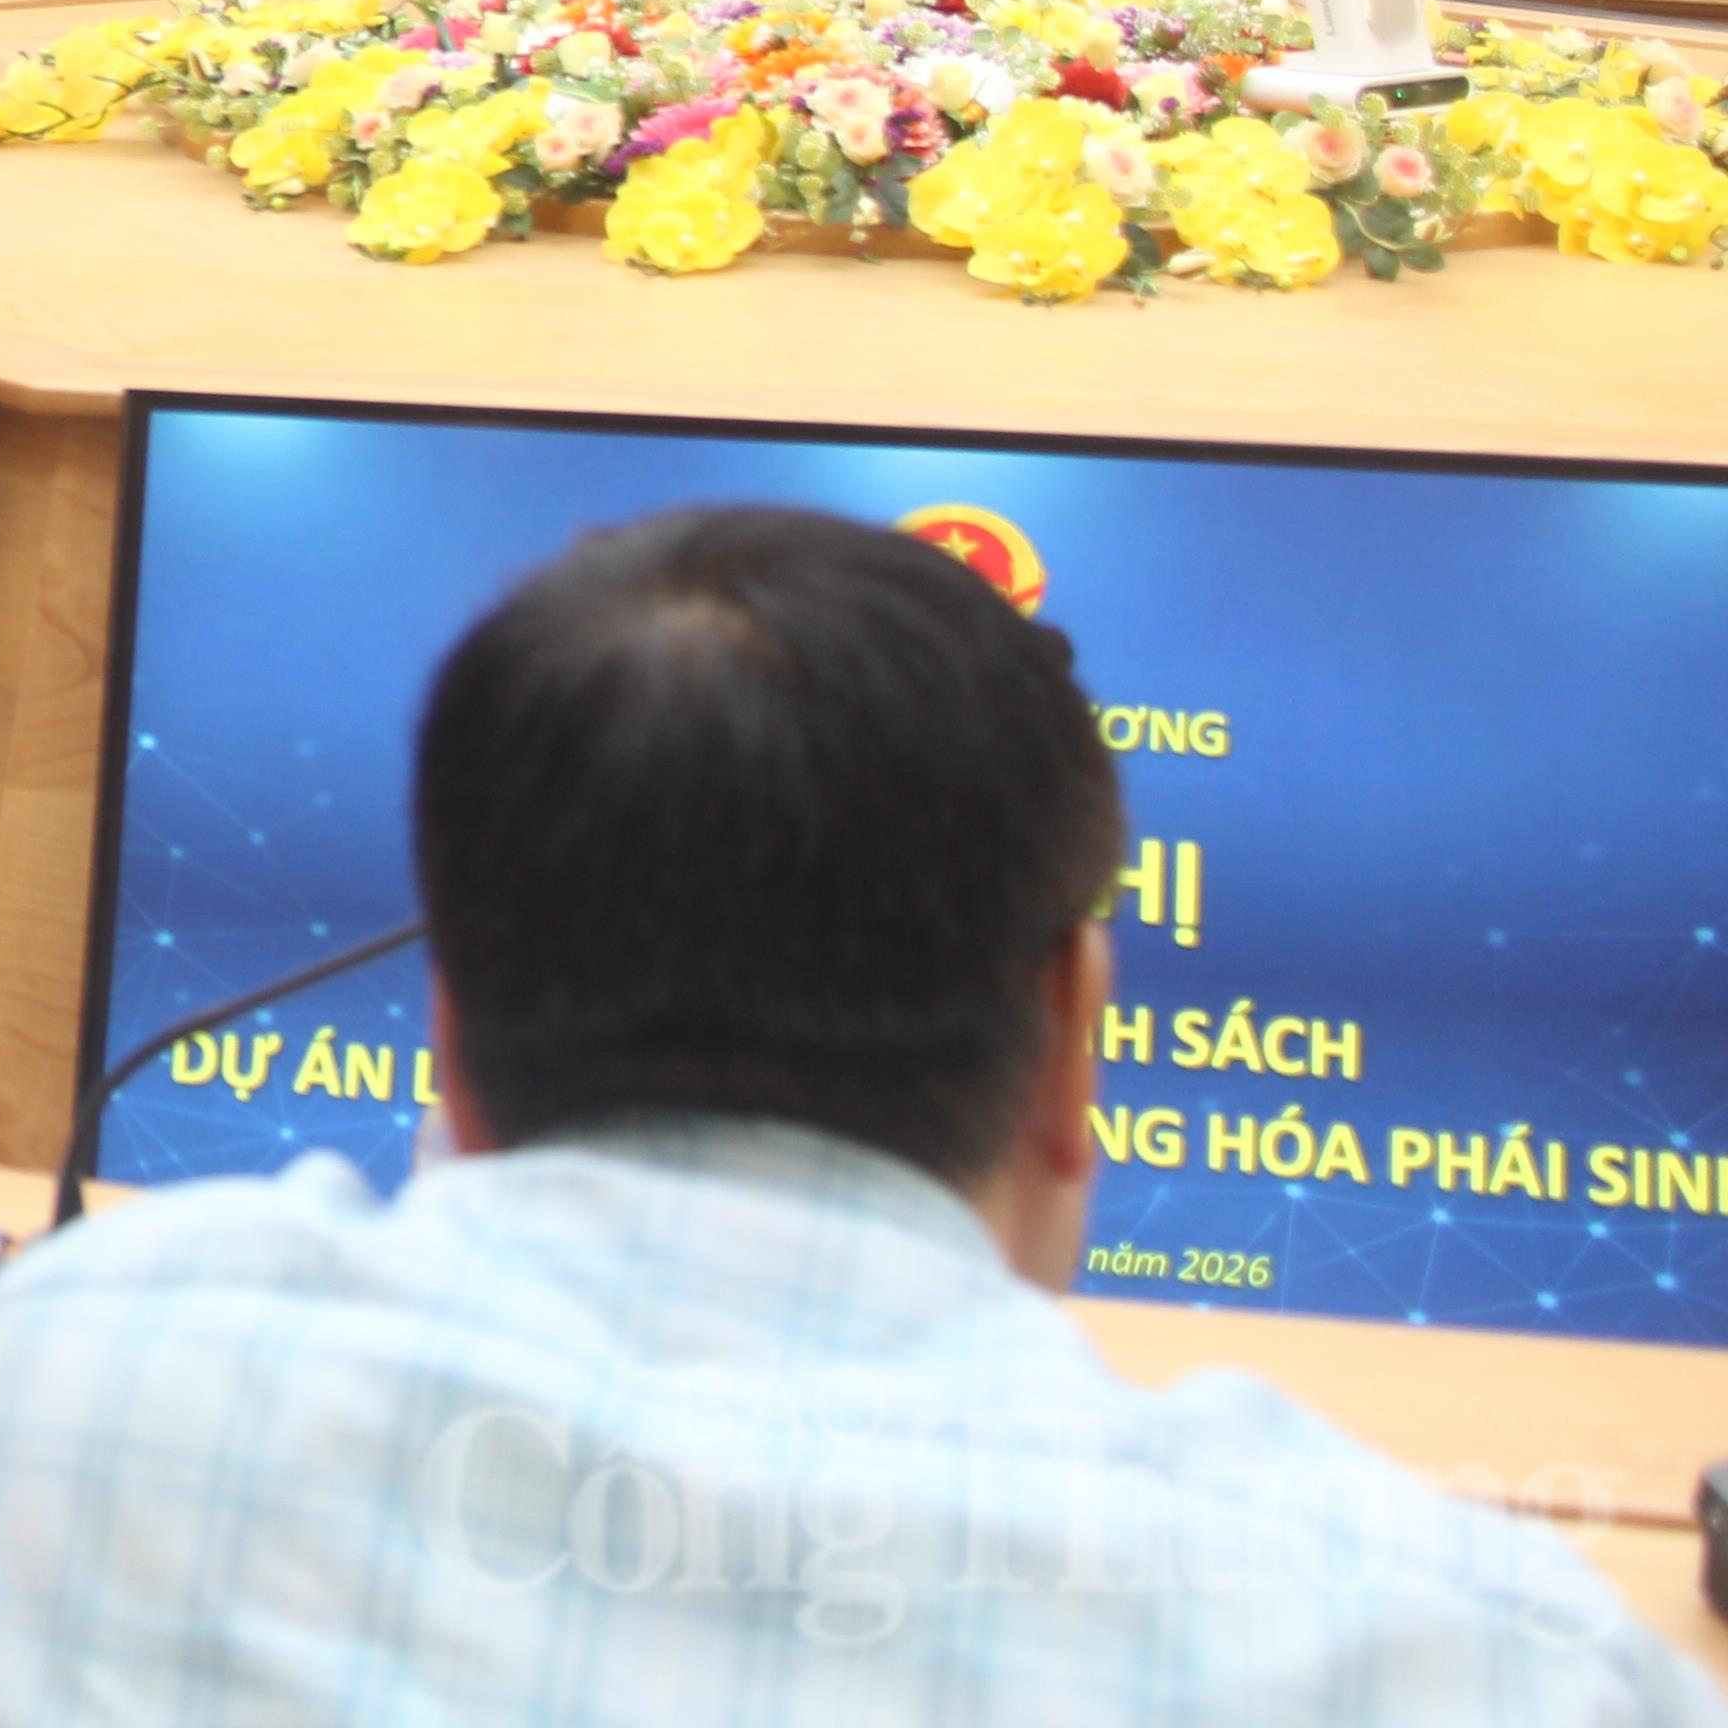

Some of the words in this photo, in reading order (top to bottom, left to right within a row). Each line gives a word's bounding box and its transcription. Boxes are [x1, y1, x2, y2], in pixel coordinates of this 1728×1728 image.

[1092, 704, 1231, 758] ƠNG
[1096, 838, 1202, 949] HỊ
[1172, 998, 1364, 1081] SÁCH
[170, 1028, 282, 1102] DỰ
[293, 1026, 394, 1101] ÁN
[1087, 1103, 1186, 1169] NG
[1207, 1104, 1370, 1184] HÓA
[1389, 1122, 1568, 1201] PHÁI
[1589, 1144, 1728, 1215] SIN
[1087, 1241, 1171, 1277] năm
[1178, 1248, 1272, 1288] 2026
